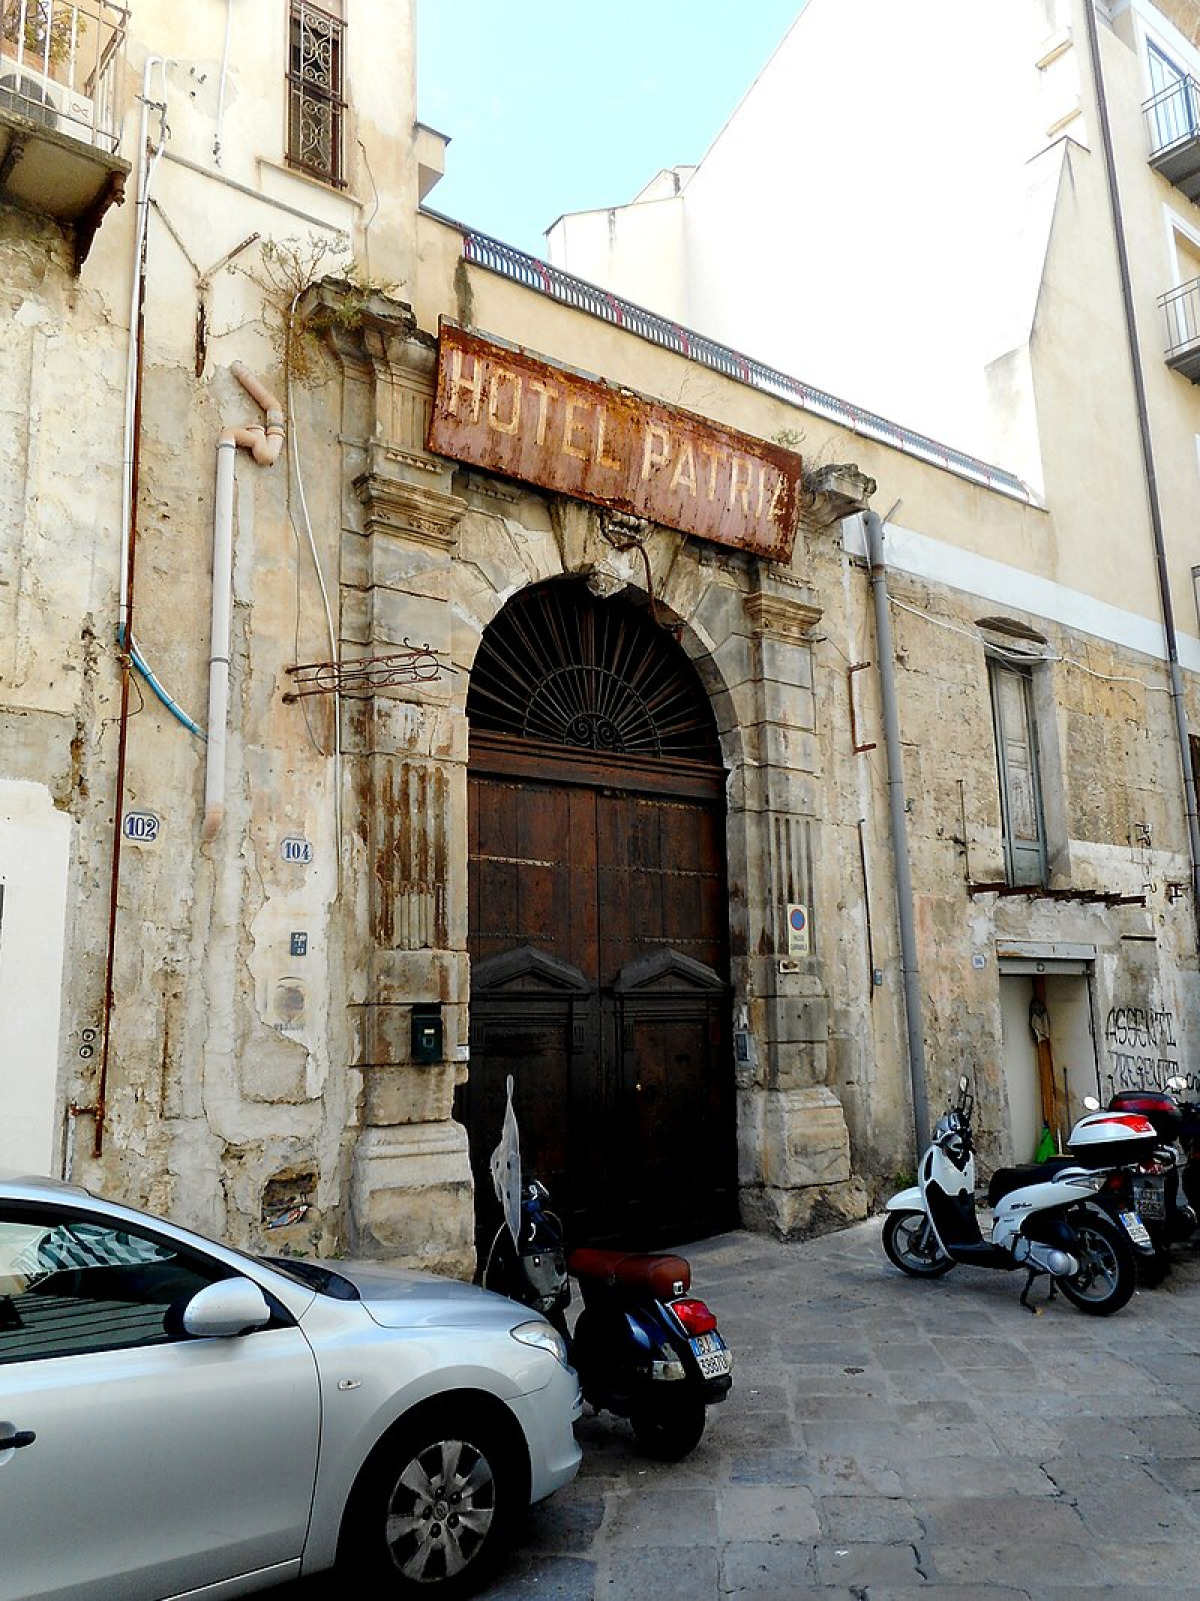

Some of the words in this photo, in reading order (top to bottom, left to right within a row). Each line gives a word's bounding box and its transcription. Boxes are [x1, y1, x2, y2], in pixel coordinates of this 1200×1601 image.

[446, 348, 622, 471] HOTEL
[126, 817, 157, 837] 102
[285, 842, 312, 861] 104
